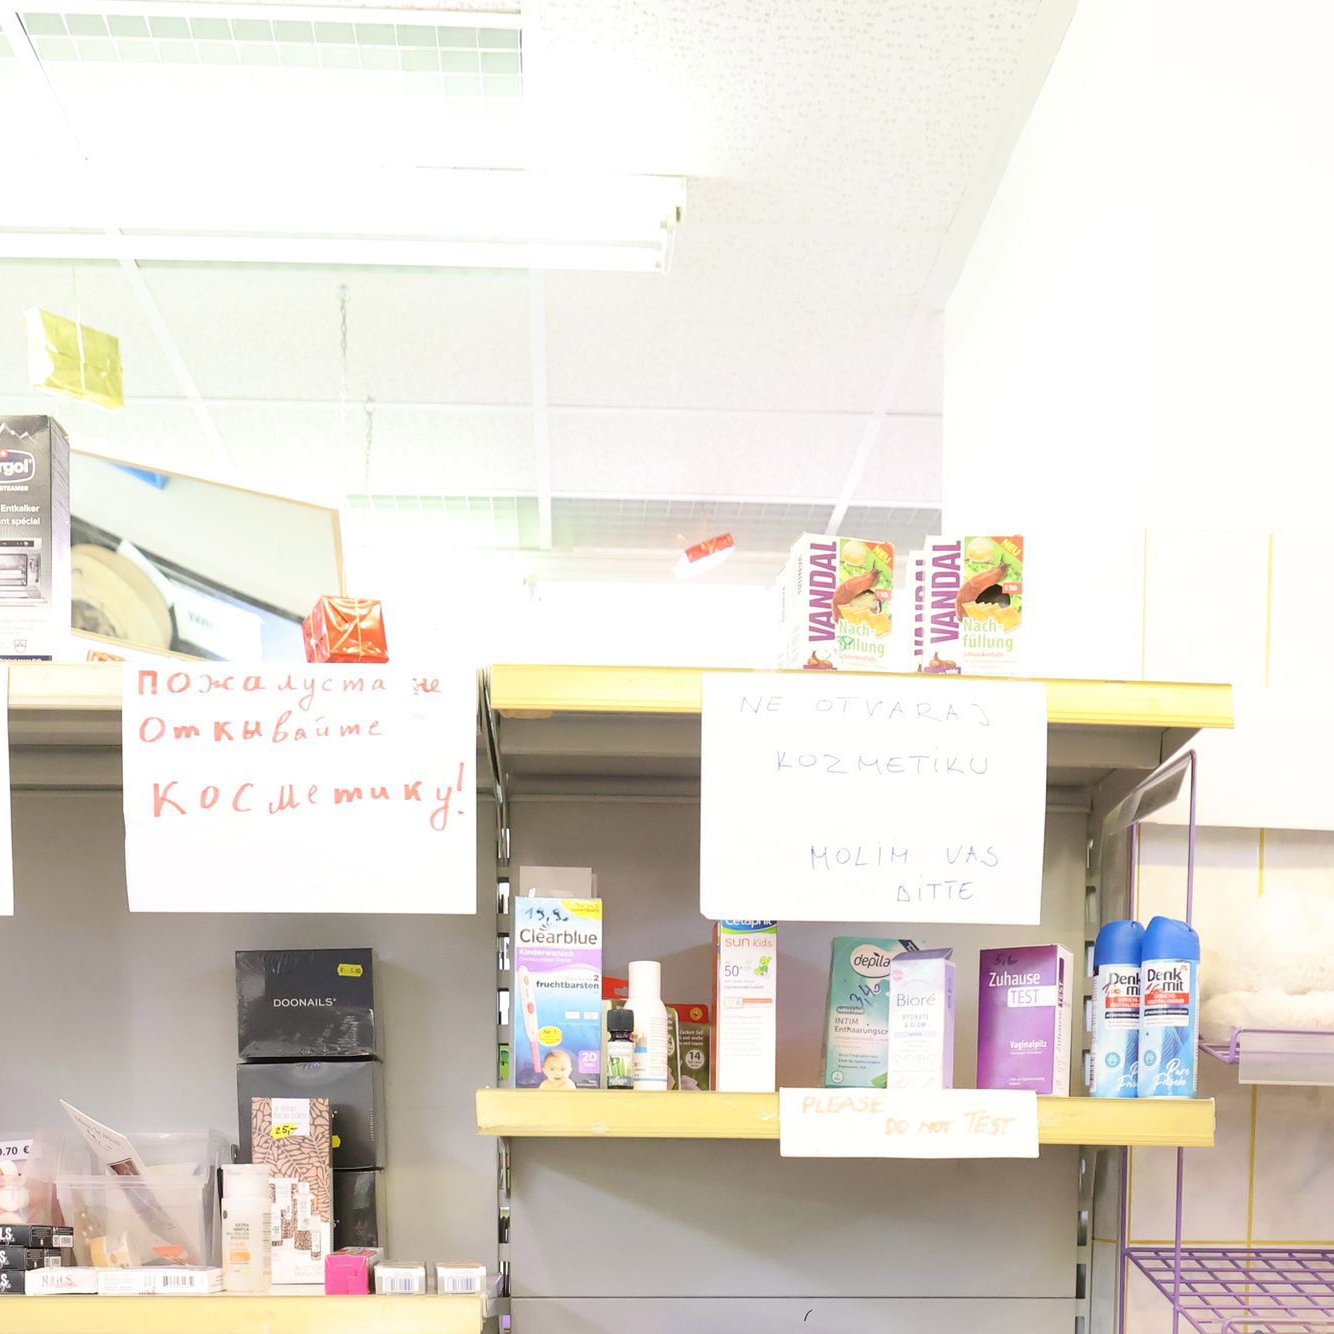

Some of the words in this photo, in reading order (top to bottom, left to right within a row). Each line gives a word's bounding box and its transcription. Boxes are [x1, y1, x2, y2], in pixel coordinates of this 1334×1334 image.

[8, 516, 40, 526] spécial
[1002, 537, 1022, 557] NEU
[872, 545, 892, 565] NEU
[808, 541, 837, 642] VANDAL
[930, 540, 962, 644] VANDAL
[839, 620, 876, 637] Nach-
[962, 619, 1002, 633] Nach-
[962, 634, 1014, 651] füllung
[740, 696, 784, 714] NE
[947, 846, 999, 867] VAS
[520, 929, 598, 944] Clearblue
[725, 938, 750, 947] sun
[753, 937, 772, 947] kids
[989, 971, 1040, 987] Zuhause
[1148, 968, 1182, 981] Denk
[536, 981, 599, 989] fruchtbarsten
[1163, 980, 1183, 991] mit
[273, 997, 334, 1007] DOONAILS
[896, 992, 936, 1007] Bioré
[1010, 989, 1039, 1004] TEST
[835, 1017, 858, 1025] INTIM
[1010, 1040, 1047, 1050] Vaginalpilz
[582, 1052, 597, 1062] 20
[689, 1051, 701, 1060] 14
[802, 1096, 884, 1114] PLEASE
[884, 1118, 908, 1135] DO
[919, 1120, 953, 1133] NOT
[23, 1146, 30, 1154] €
